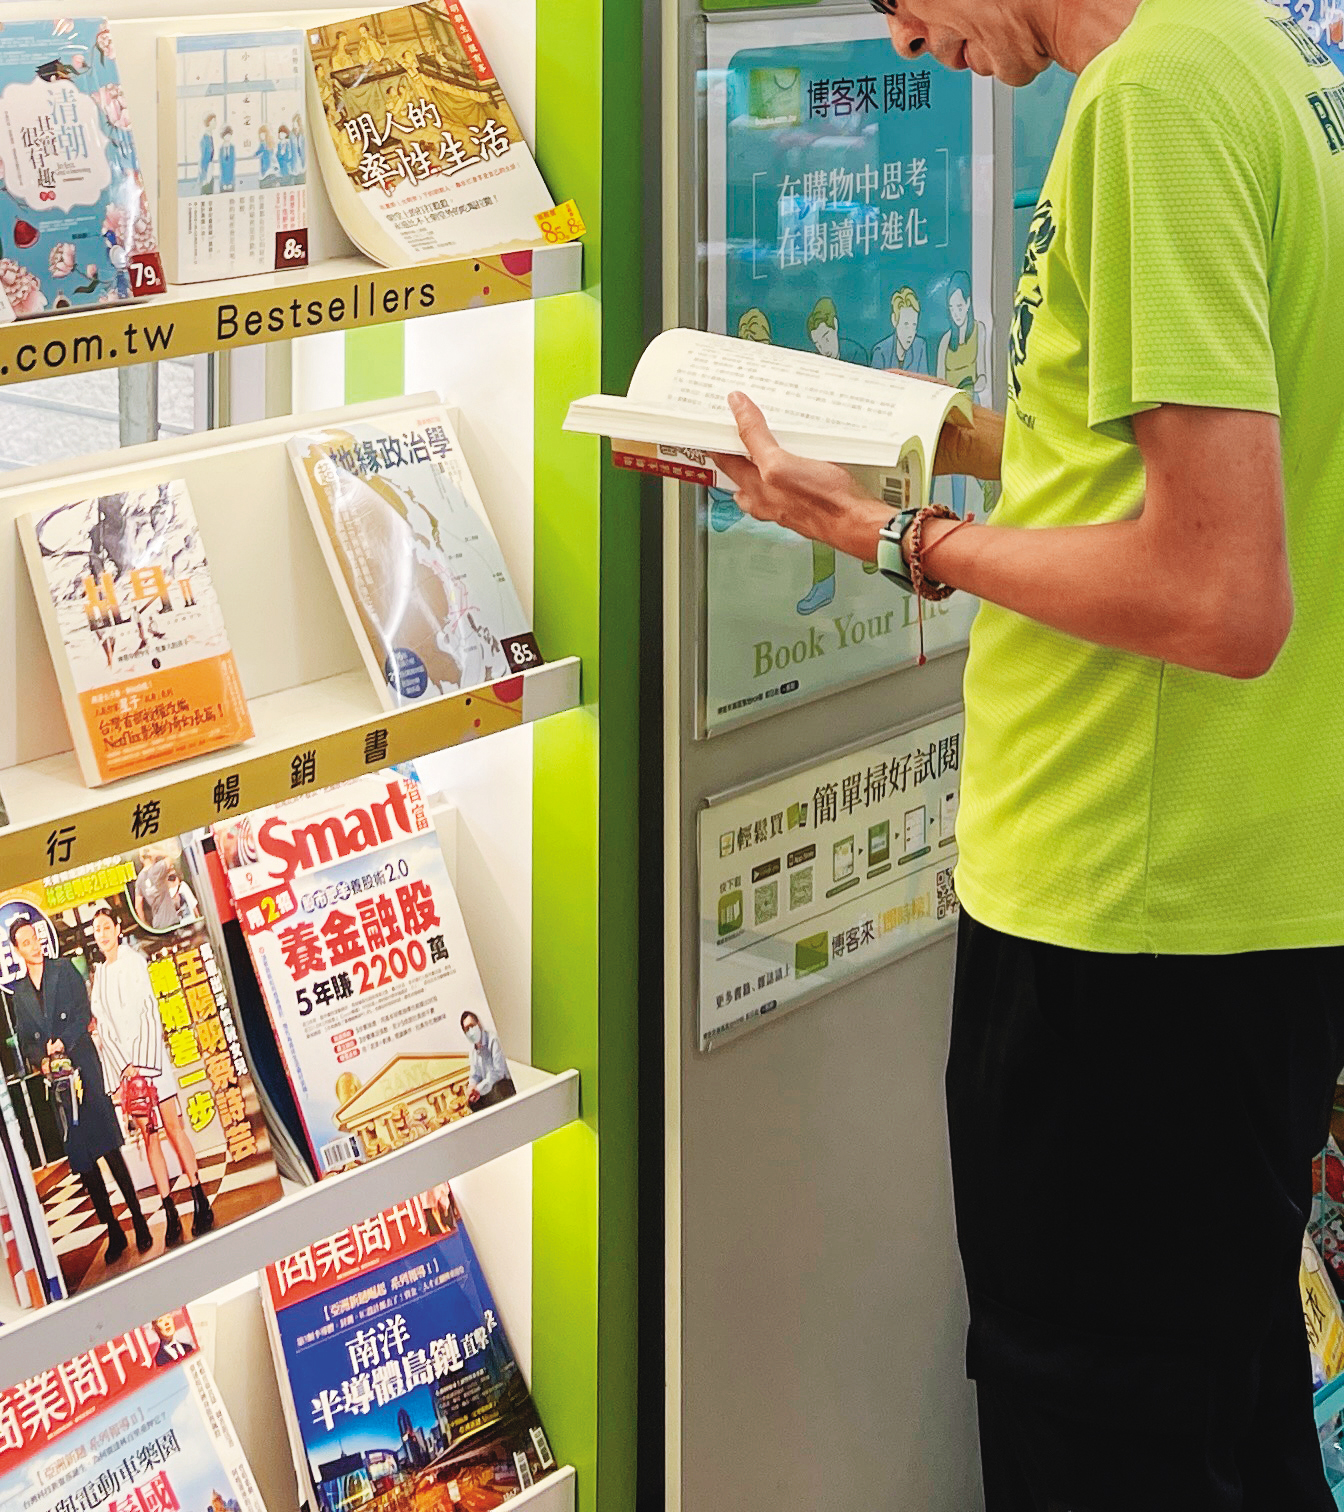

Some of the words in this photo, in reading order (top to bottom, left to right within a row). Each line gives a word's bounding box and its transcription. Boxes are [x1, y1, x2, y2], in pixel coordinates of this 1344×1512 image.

[48, 90, 88, 161] 清朝
[343, 98, 443, 154] 明人的
[357, 118, 511, 197] 率性生活
[776, 157, 929, 214] 在購物中思考
[776, 208, 929, 271] 在閱讀中進化
[217, 282, 435, 340] Bestsellers
[330, 425, 452, 476] 地緣政治學
[752, 629, 825, 679] Book
[833, 608, 895, 650] Your
[403, 778, 429, 832] 智富
[812, 732, 961, 830] 簡單掃好試閱
[258, 780, 413, 879] Smart
[277, 879, 441, 982] 養金融股
[832, 919, 875, 960] 博客來
[345, 1314, 410, 1374] 南洋
